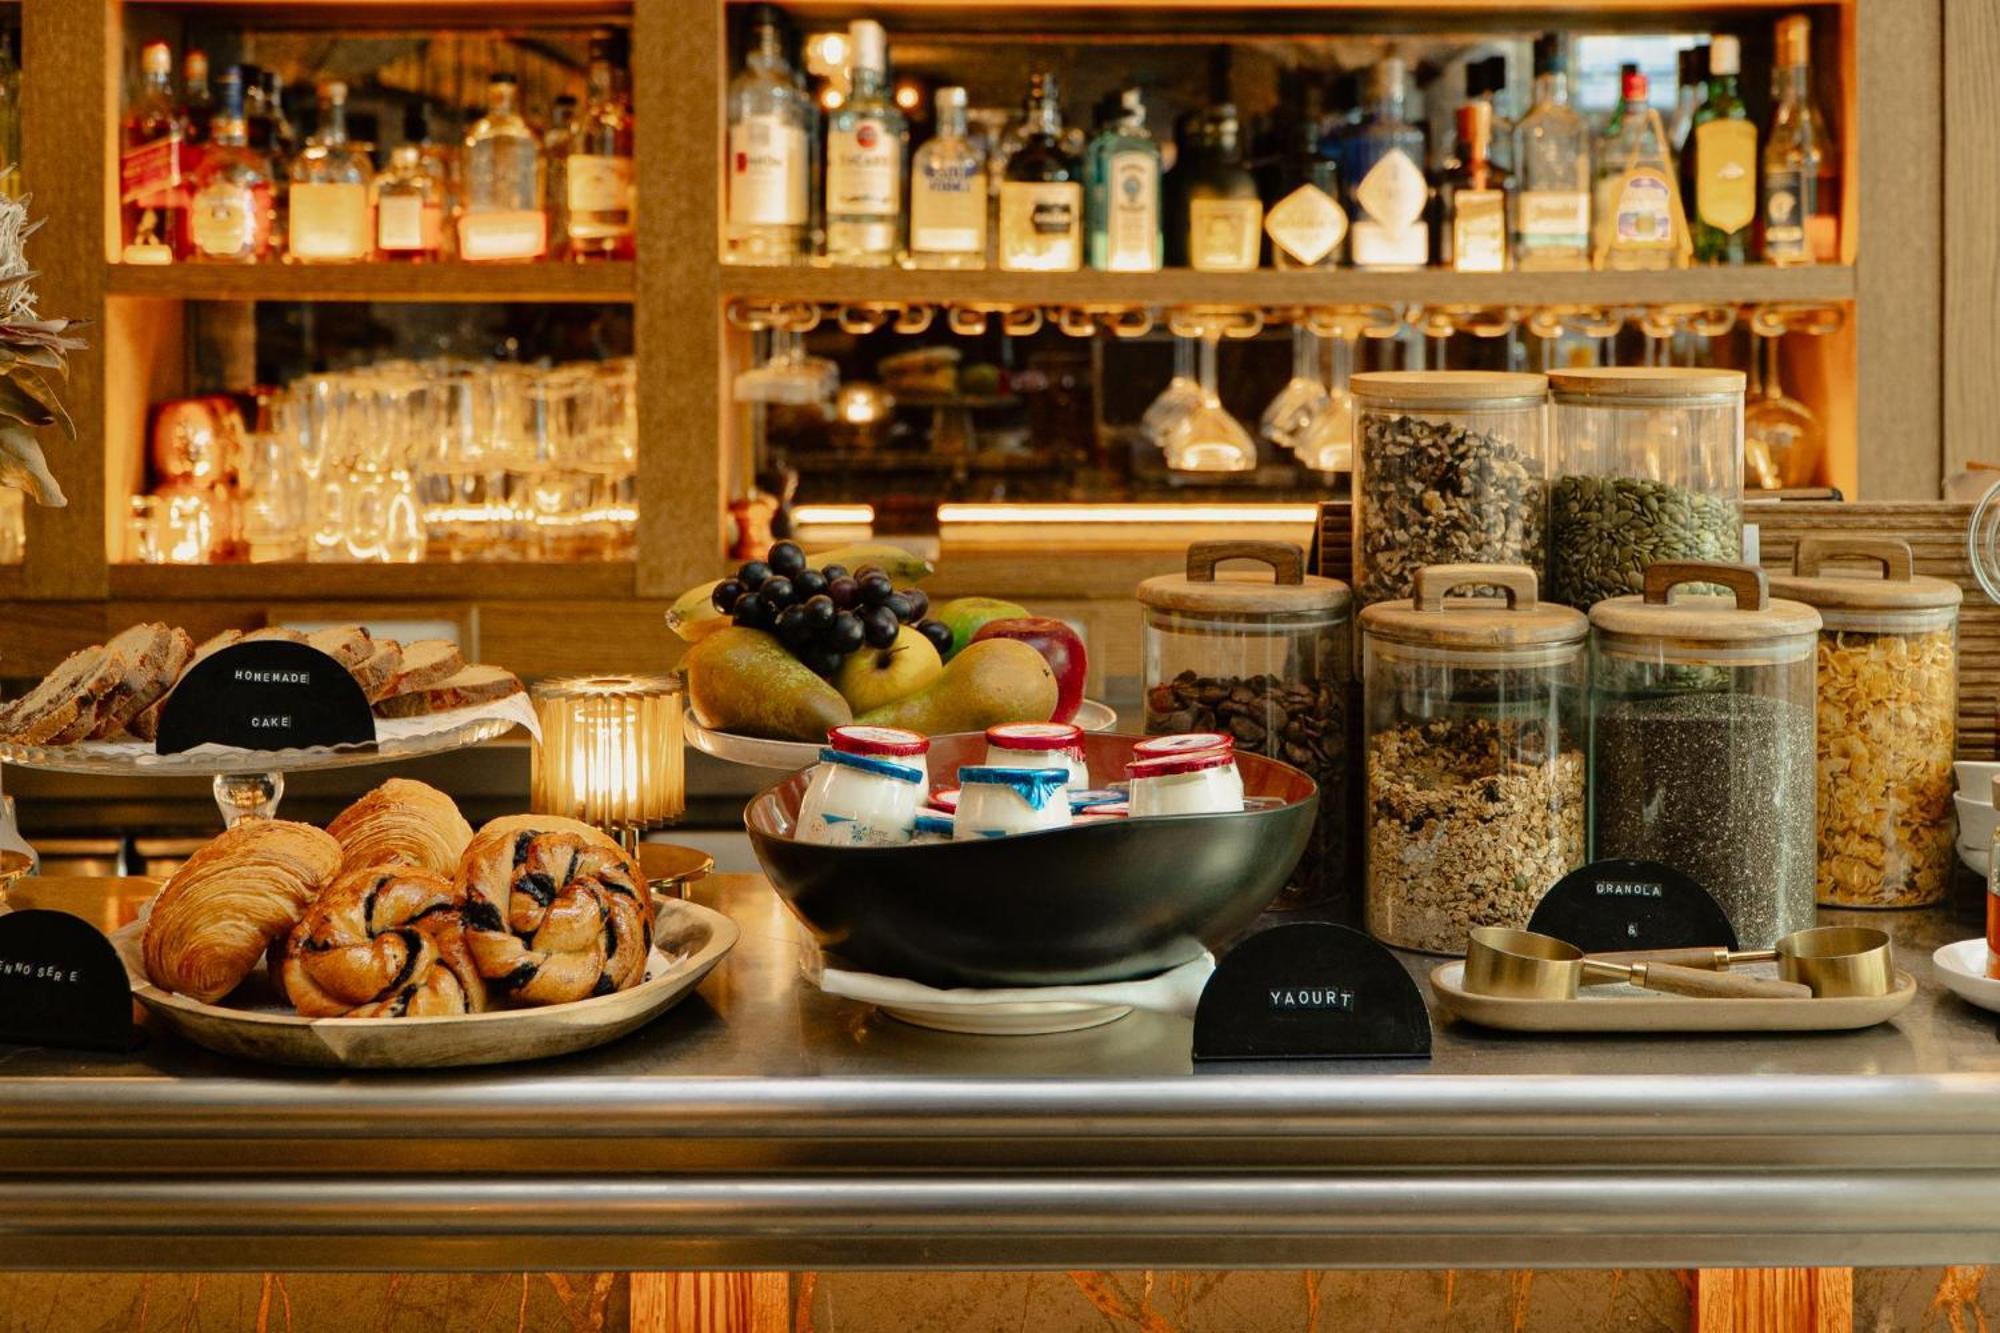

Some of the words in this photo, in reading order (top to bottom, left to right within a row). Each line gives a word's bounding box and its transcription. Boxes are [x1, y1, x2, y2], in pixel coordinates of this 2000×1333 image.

[235, 670, 308, 684] HOMEMADE
[251, 717, 289, 728] CAKE
[1596, 883, 1661, 896] GRANOLA
[1270, 991, 1351, 1007] YAOURT
